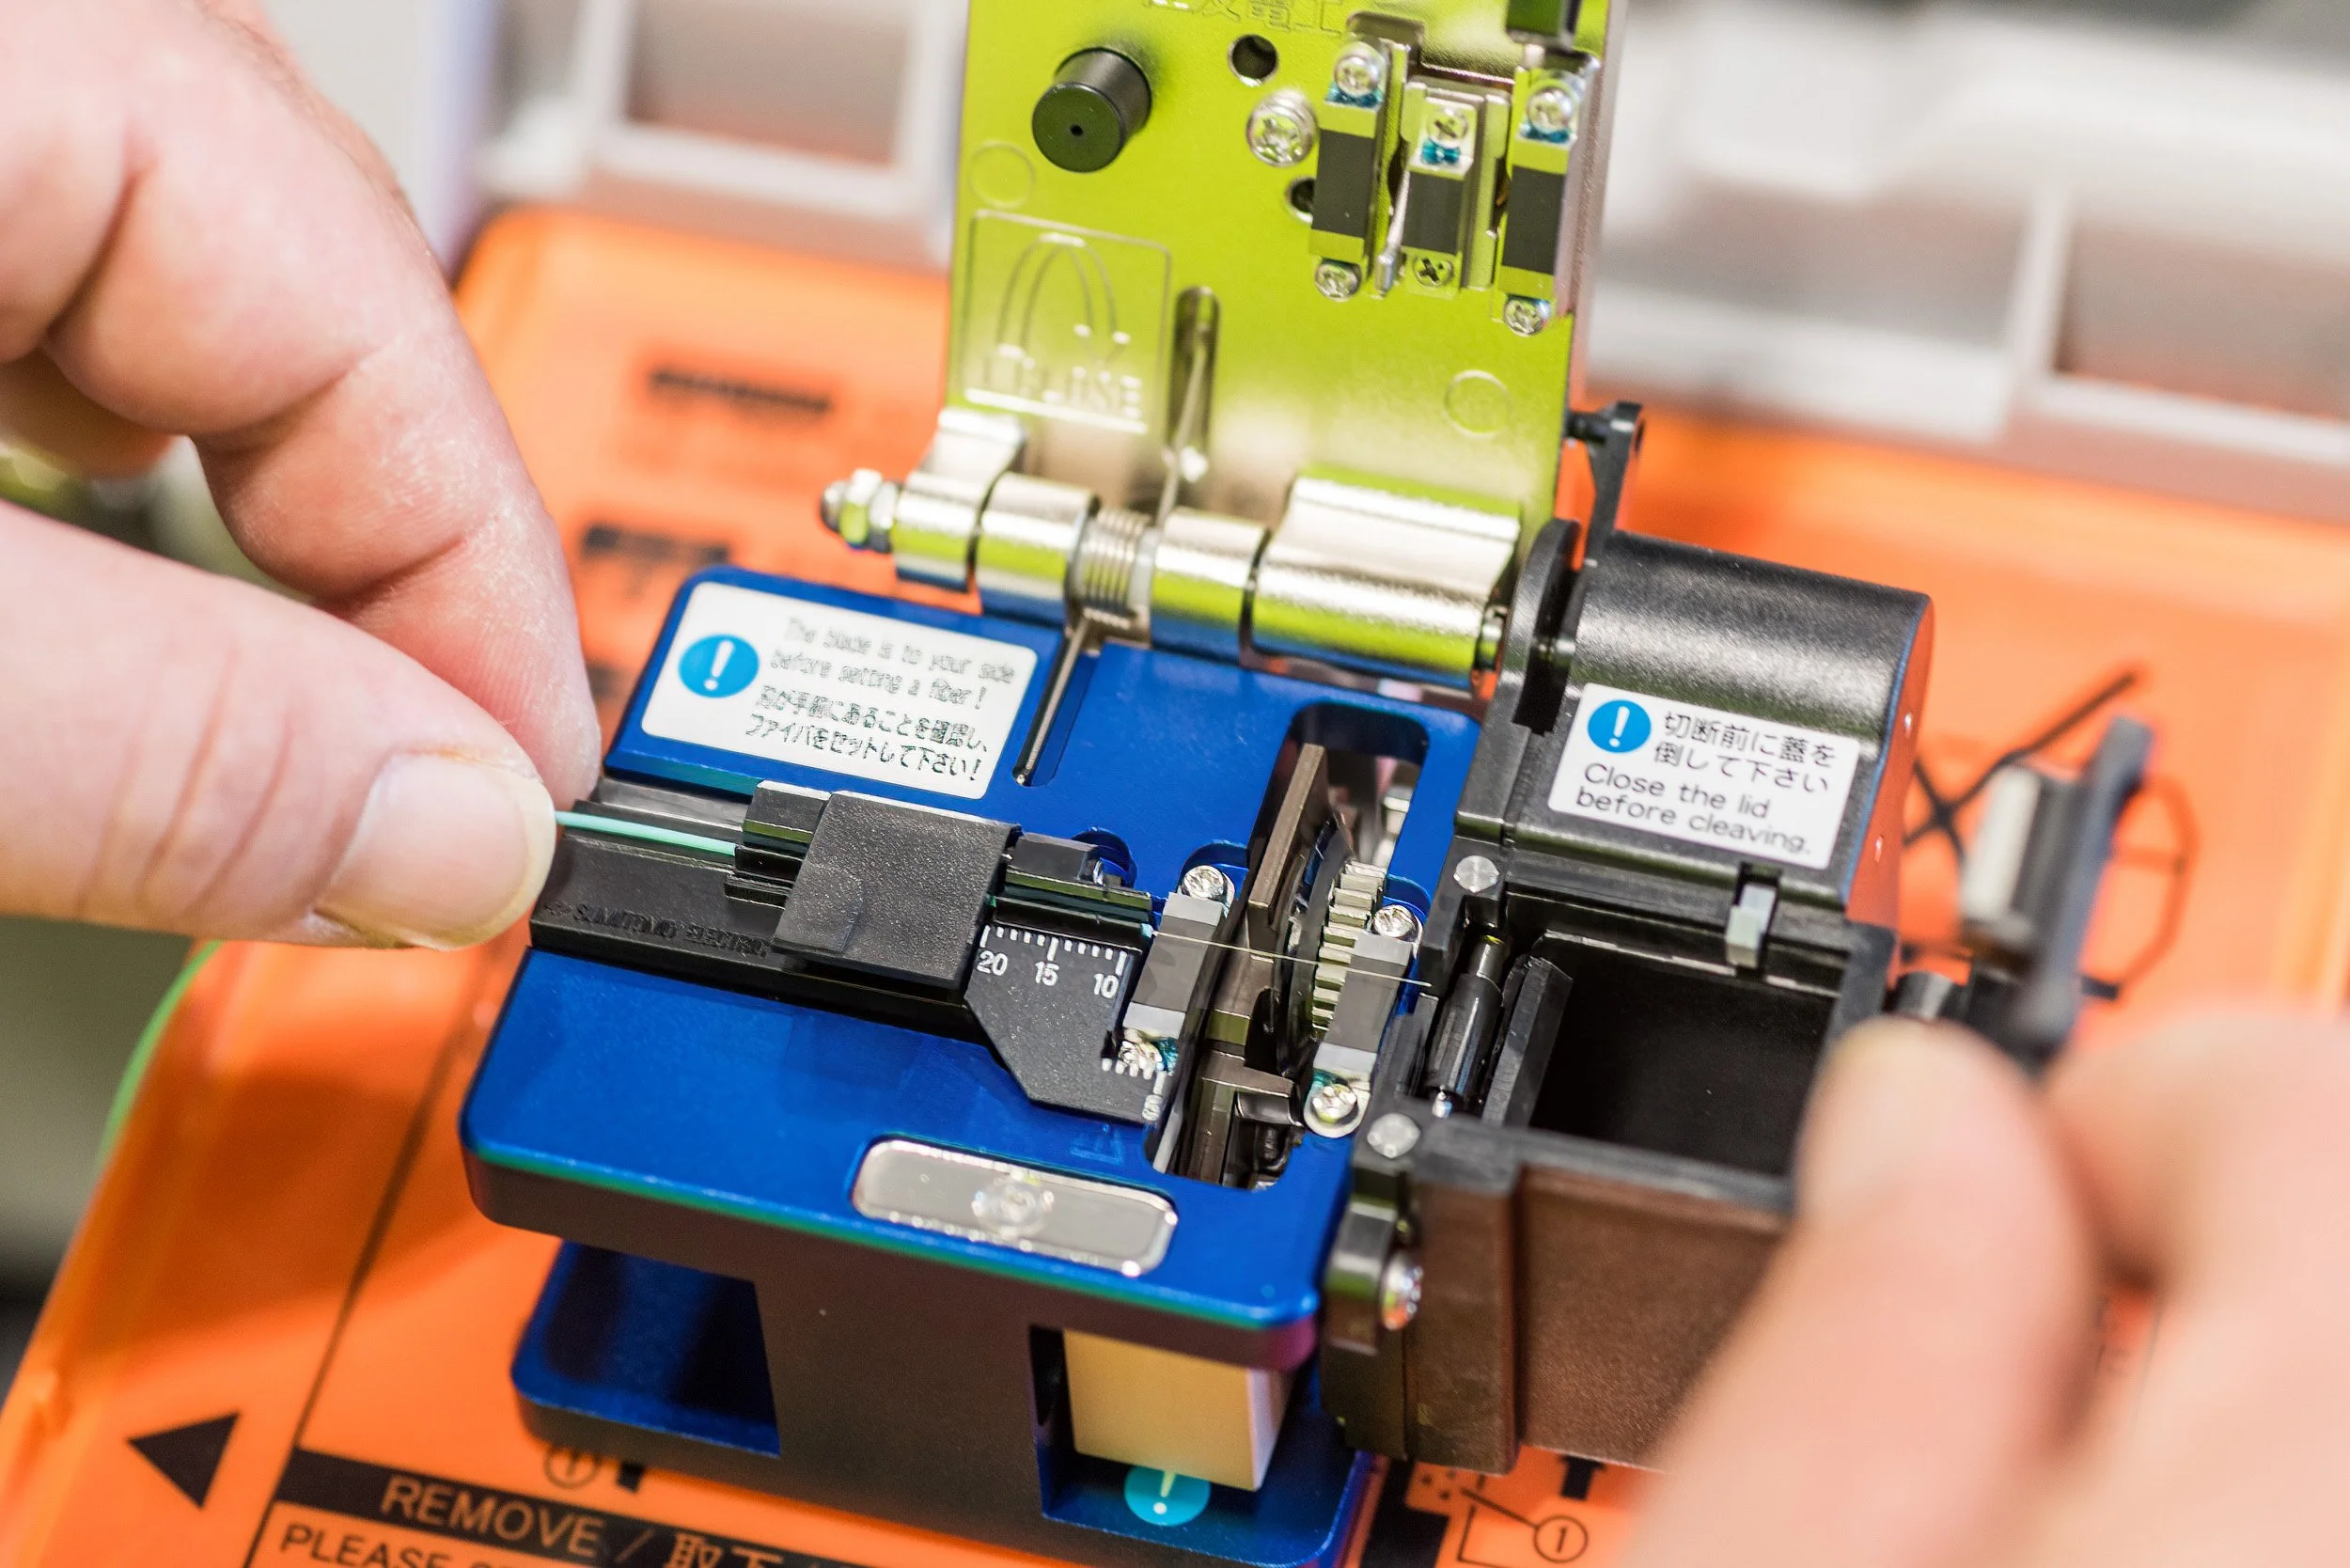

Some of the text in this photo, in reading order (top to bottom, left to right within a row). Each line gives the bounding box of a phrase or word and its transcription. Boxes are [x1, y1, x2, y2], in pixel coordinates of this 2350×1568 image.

[1654, 740, 1828, 793] 倒して下さい
[1664, 711, 1836, 768] 切断前に蓋を
[1575, 785, 1812, 855] before cleaving.
[1584, 761, 1771, 821] Close the lid
[976, 949, 1120, 999] 20 15 10
[379, 1473, 606, 1559] REMOVE
